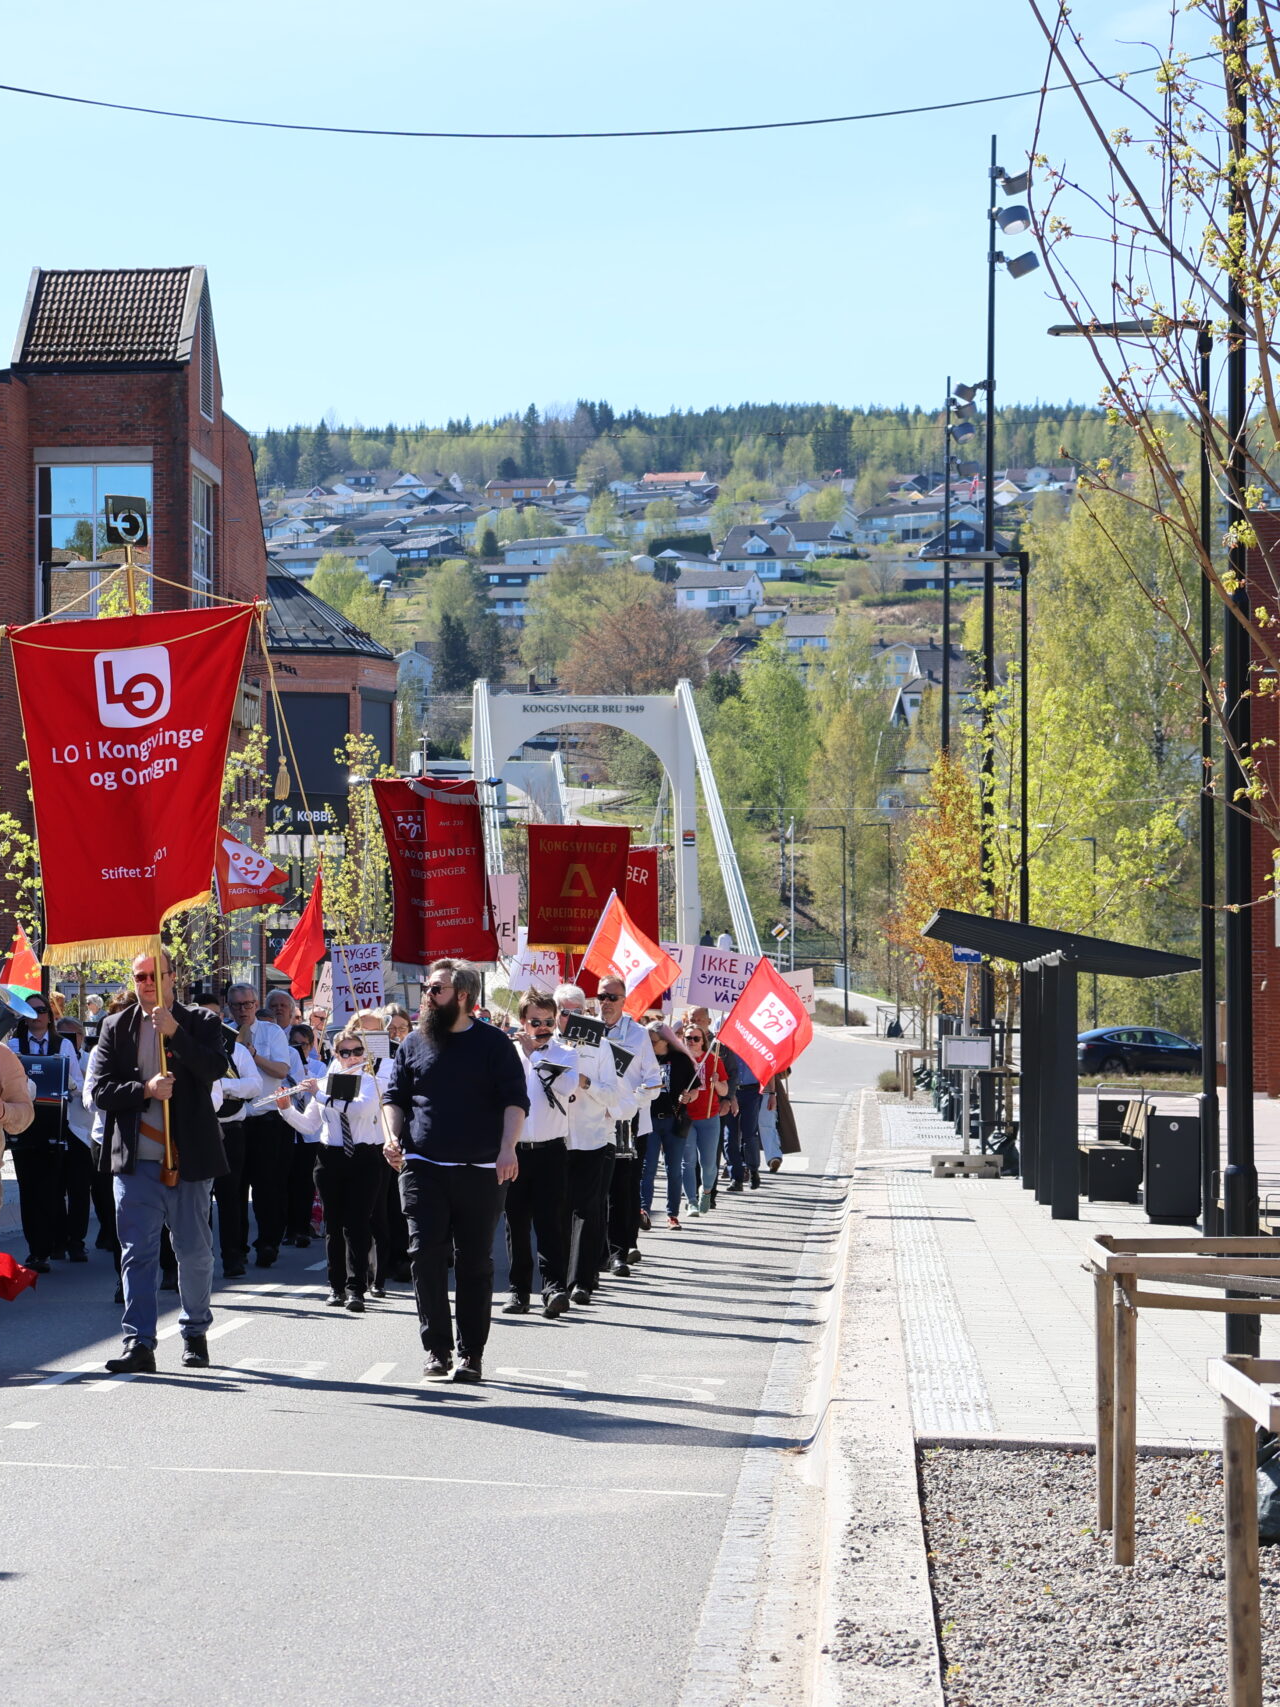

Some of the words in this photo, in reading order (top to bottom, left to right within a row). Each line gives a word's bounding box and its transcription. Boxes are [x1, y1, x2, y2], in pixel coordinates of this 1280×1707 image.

[103, 661, 164, 718] LO
[522, 704, 600, 713] KONGSVINGER
[602, 704, 623, 713] BRU
[625, 705, 645, 713] 1949
[52, 744, 79, 764] LO
[86, 742, 91, 760] i
[98, 724, 208, 761] Kongsvinge
[90, 771, 117, 790] og
[539, 839, 617, 854] KONGSVINGER
[101, 866, 141, 880] Stiftet
[436, 917, 474, 927] SAMHOLD
[334, 947, 378, 962] TRYGGE
[702, 954, 738, 974] IKKE
